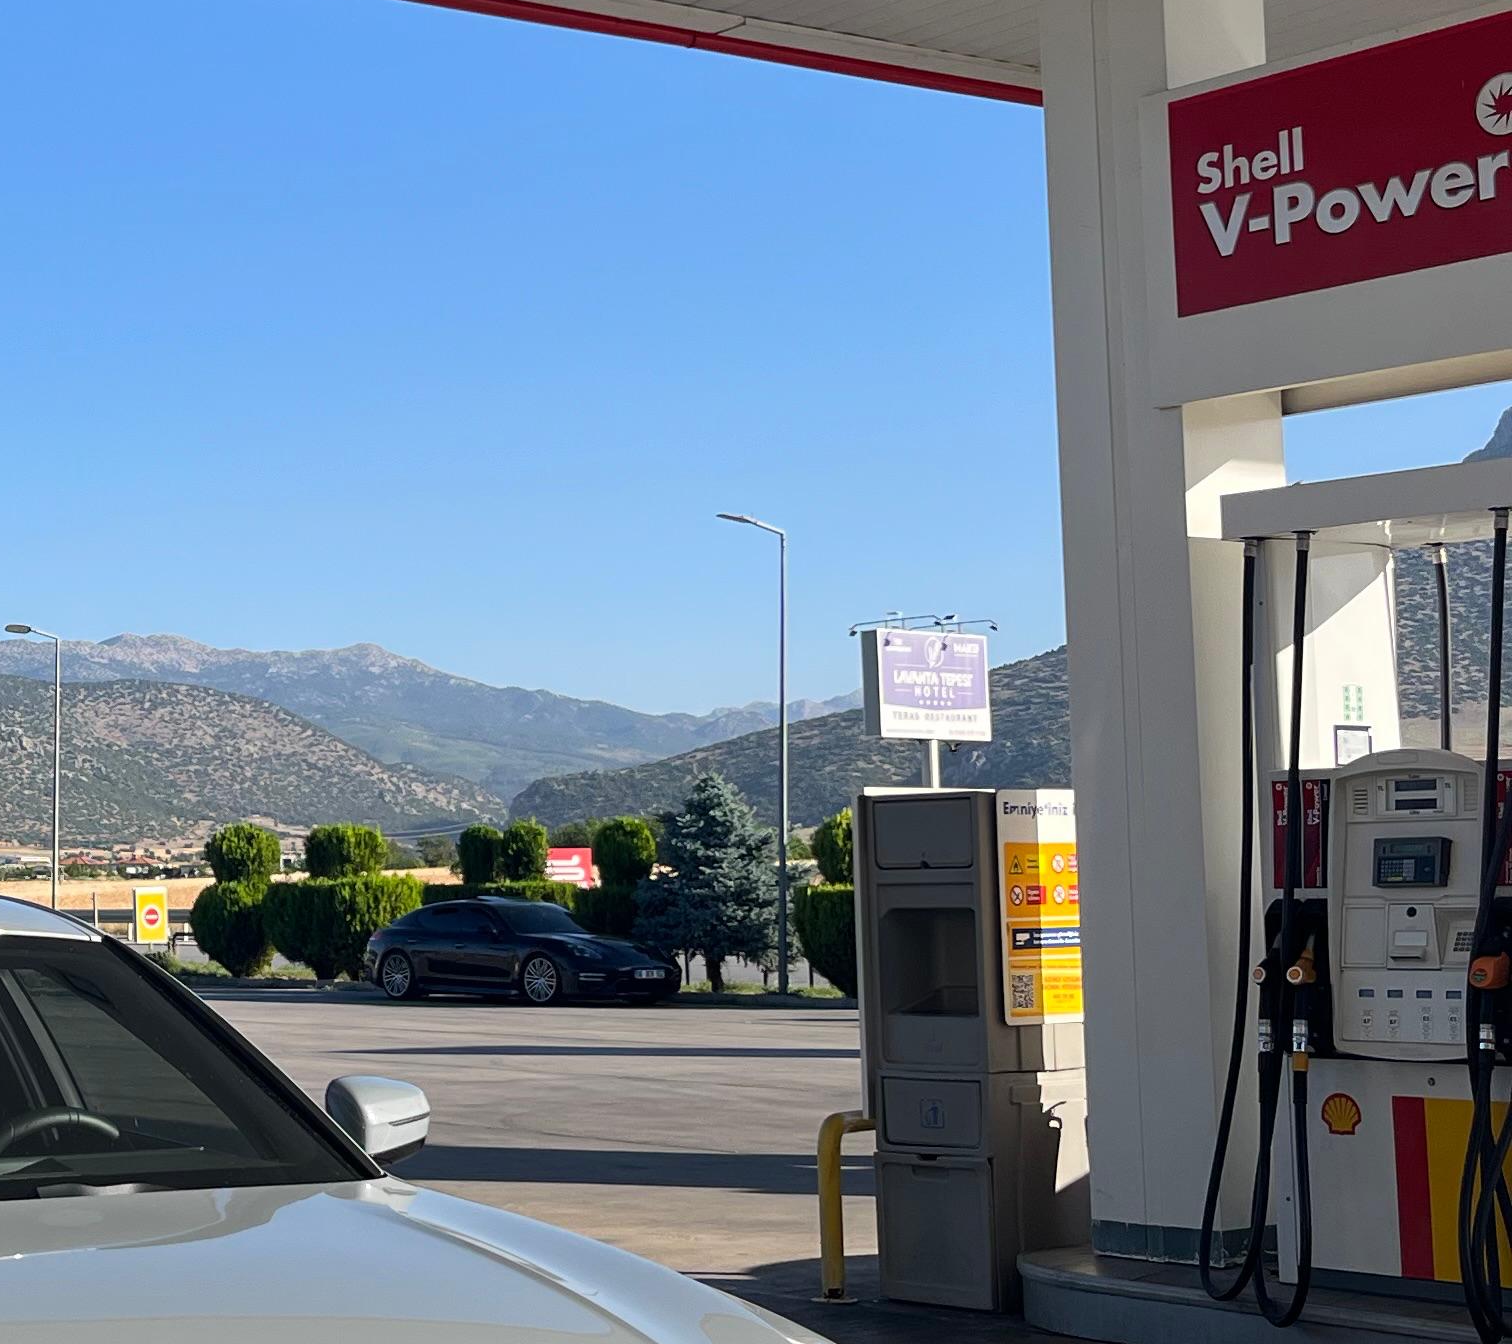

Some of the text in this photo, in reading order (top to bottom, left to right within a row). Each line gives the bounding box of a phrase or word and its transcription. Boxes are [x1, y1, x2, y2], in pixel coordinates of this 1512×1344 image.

[1196, 126, 1305, 195] Shell
[1198, 149, 1510, 258] V-Power
[914, 685, 956, 698] HOTEL
